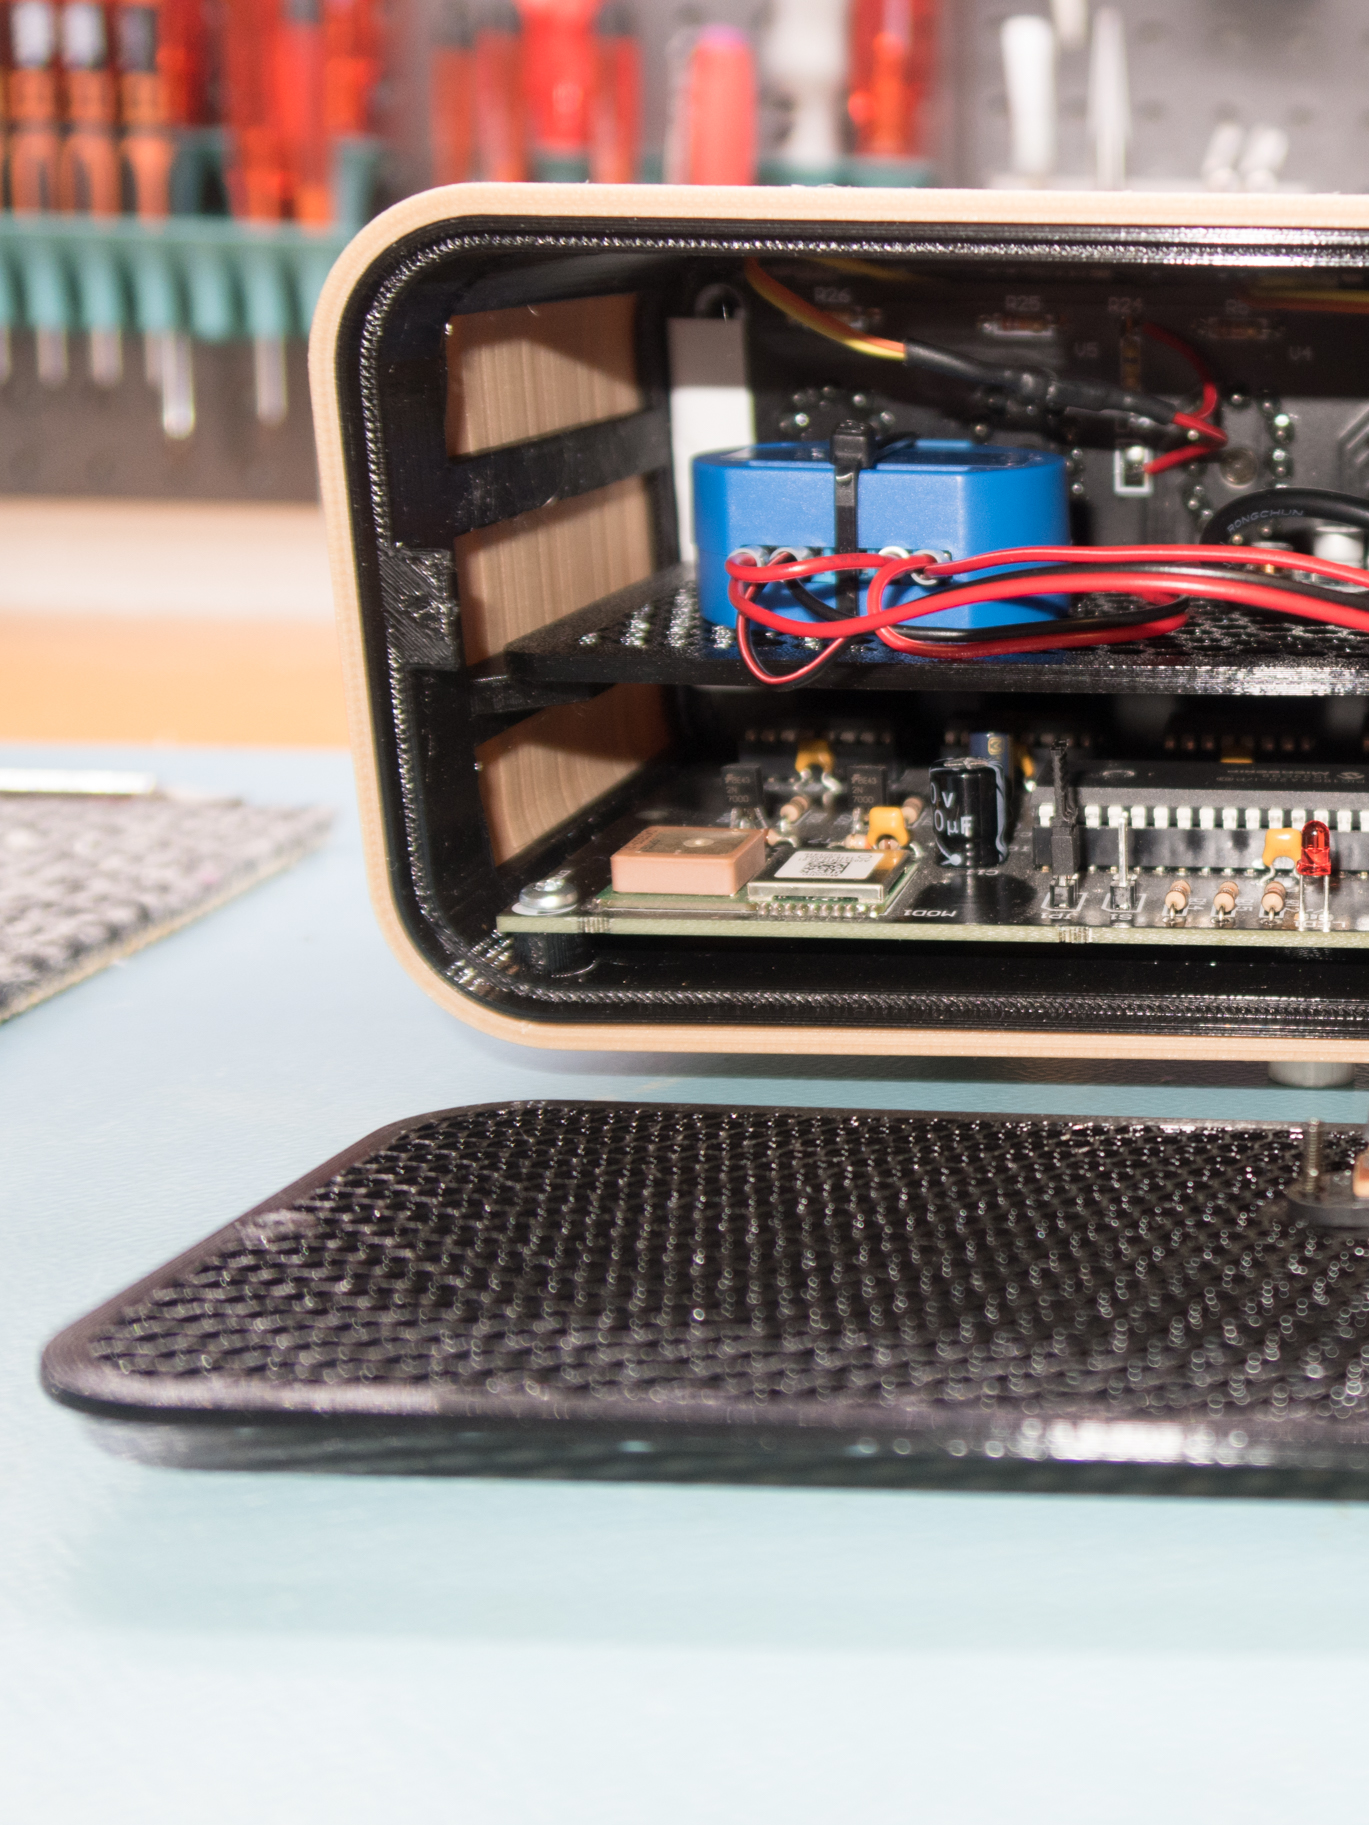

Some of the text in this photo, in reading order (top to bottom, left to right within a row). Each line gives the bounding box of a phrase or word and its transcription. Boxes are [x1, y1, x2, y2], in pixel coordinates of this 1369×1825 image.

[814, 286, 851, 302] R26
[1005, 295, 1041, 312] R25
[725, 785, 738, 794] 2N
[851, 785, 864, 794] 2N
[852, 795, 875, 803] 7000
[966, 868, 999, 876] C11
[903, 909, 957, 918] MOD1
[1040, 911, 1079, 920] JP1
[1109, 912, 1133, 921] S1
